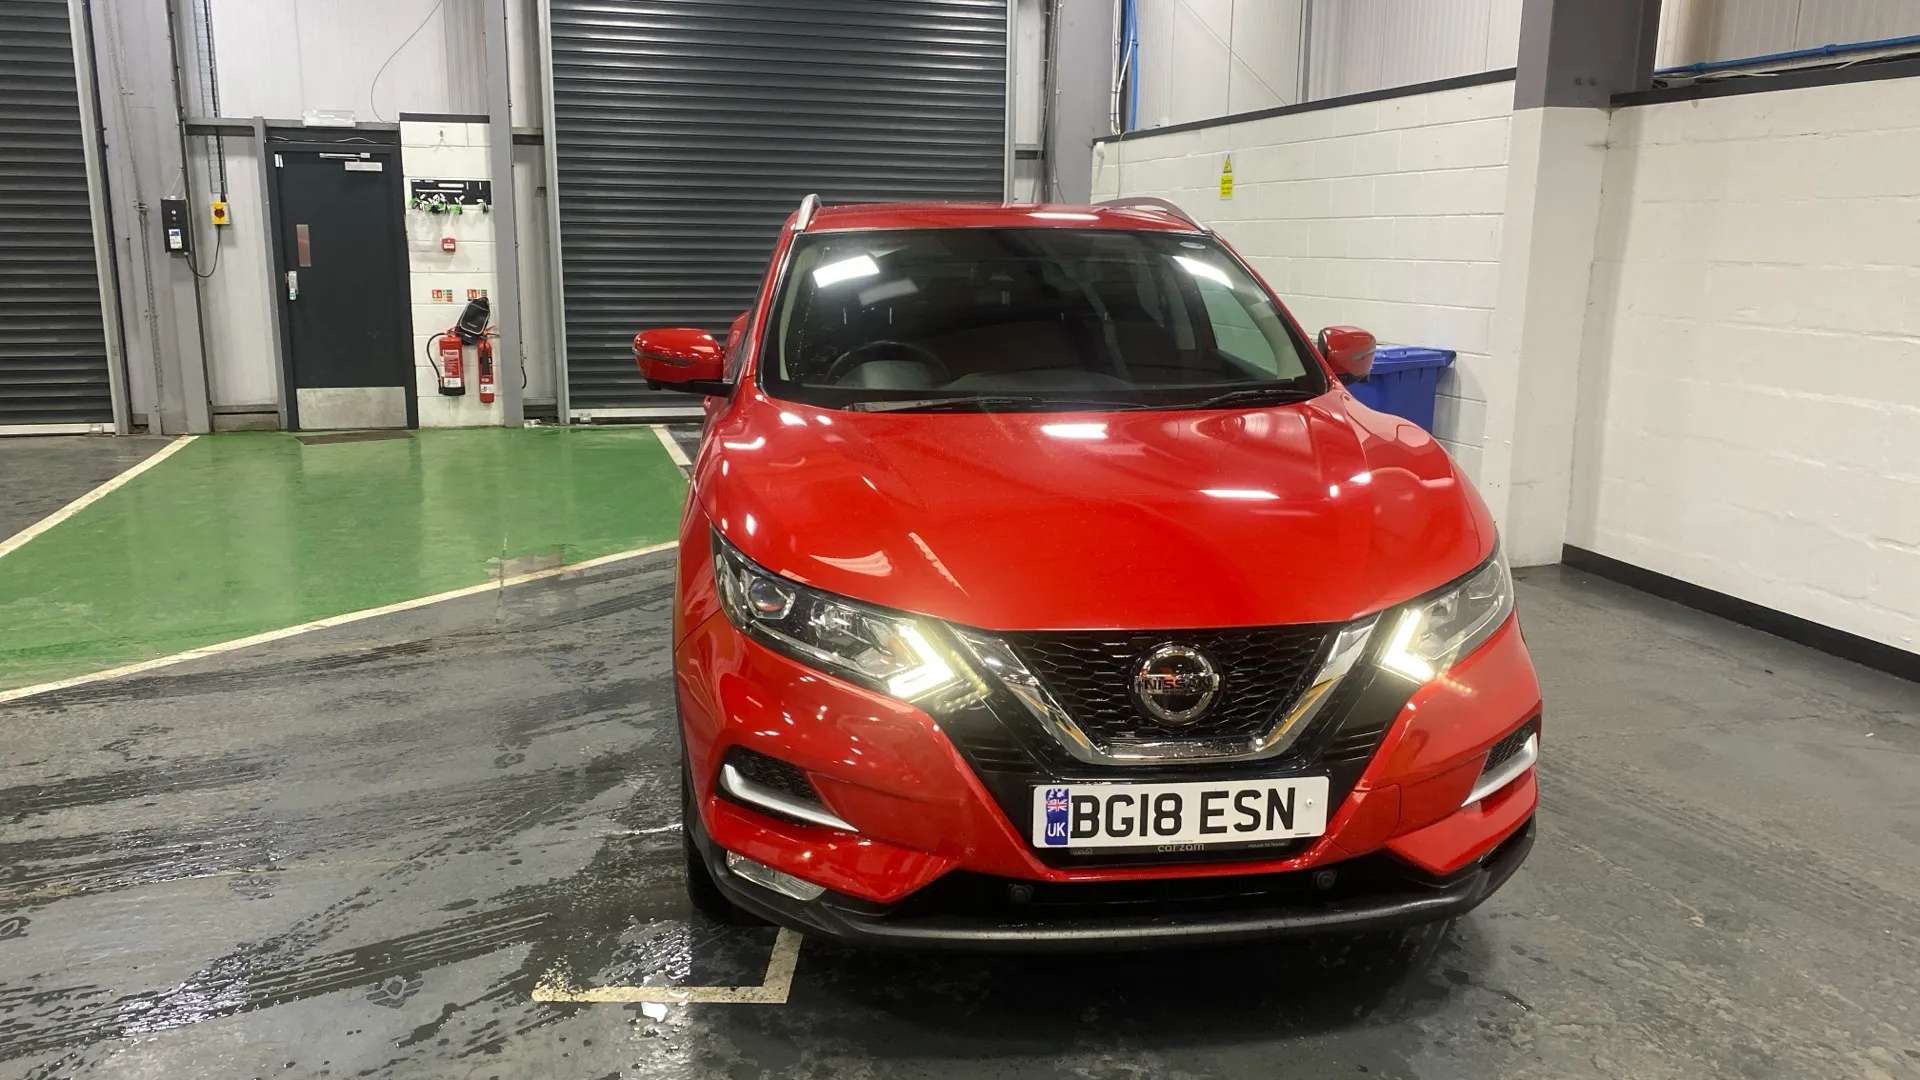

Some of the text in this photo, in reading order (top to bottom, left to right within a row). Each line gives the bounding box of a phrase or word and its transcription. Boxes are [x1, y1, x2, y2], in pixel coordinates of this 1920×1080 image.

[1142, 676, 1211, 690] NISSAN
[1070, 787, 1295, 839] BG18 ESN
[1047, 822, 1066, 837] UK
